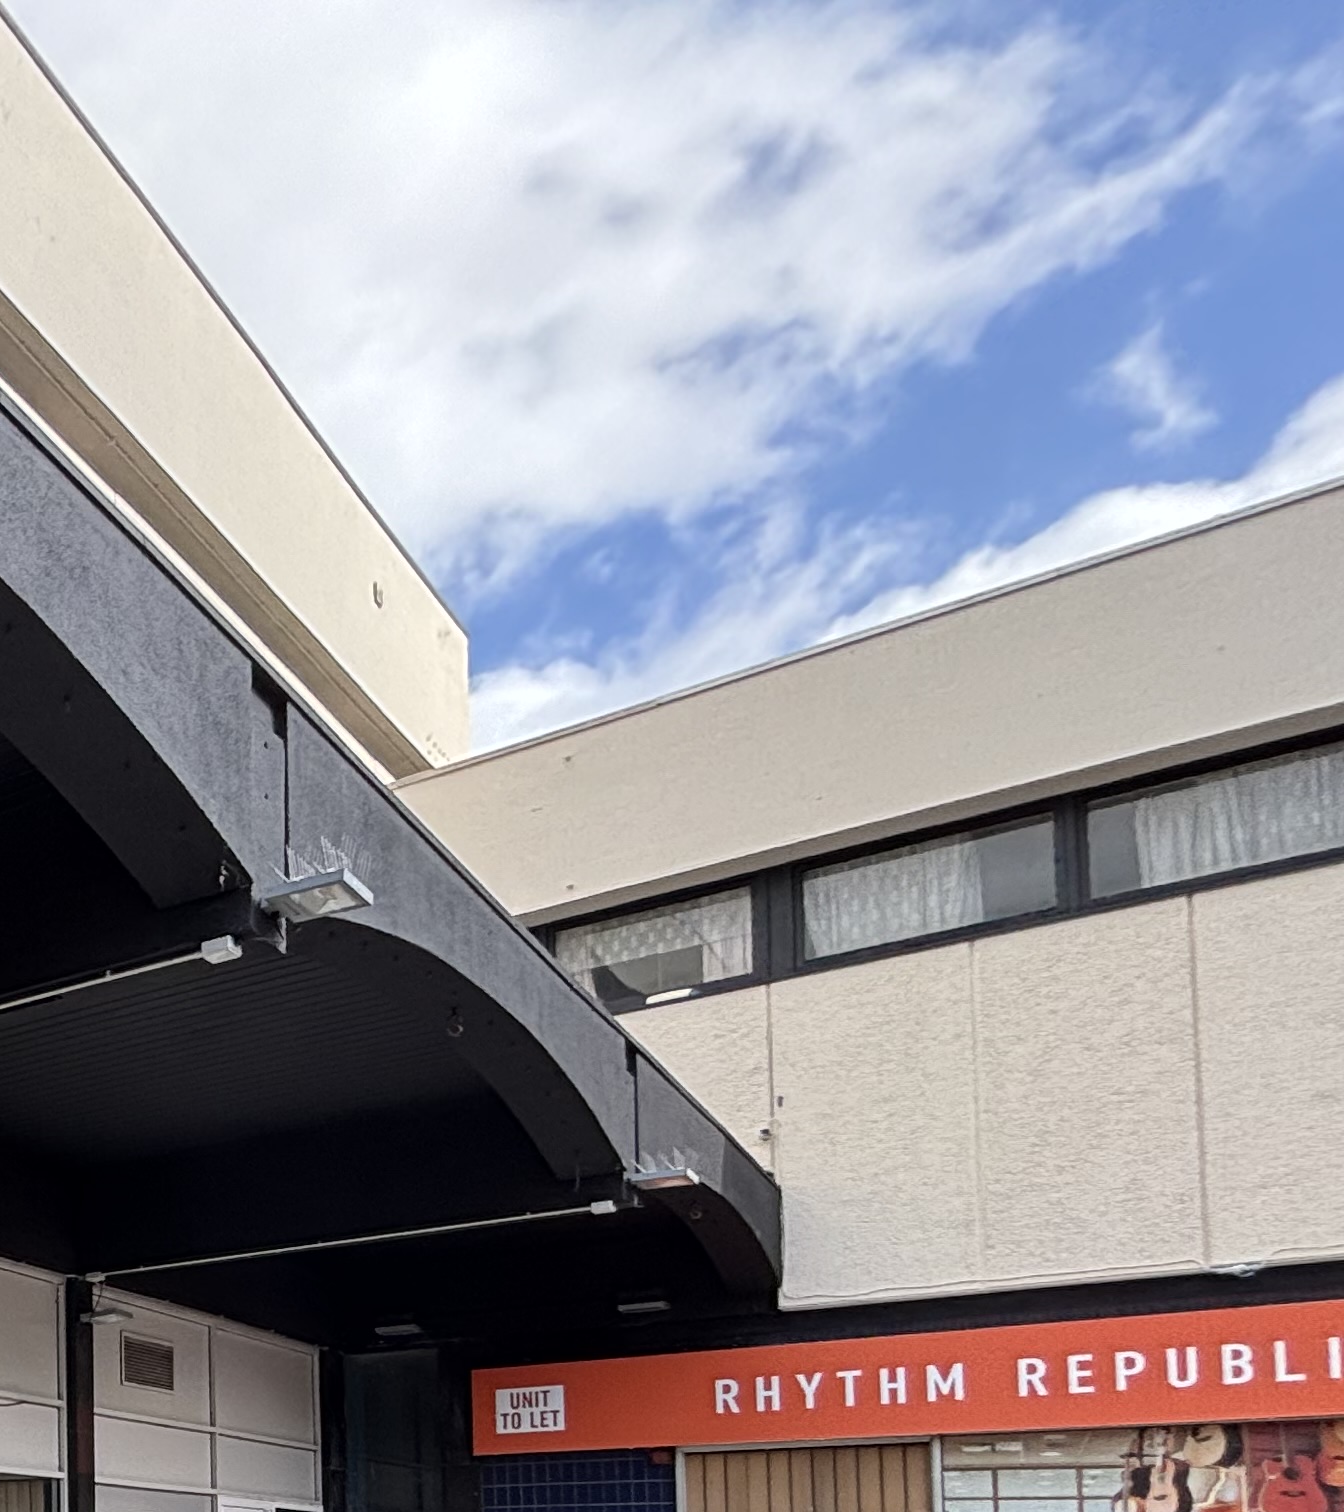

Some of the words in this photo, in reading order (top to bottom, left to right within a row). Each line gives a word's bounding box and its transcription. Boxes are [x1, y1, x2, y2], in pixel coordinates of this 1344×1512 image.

[713, 1361, 966, 1415] RHYTHM
[509, 1390, 551, 1410] UNIT
[500, 1412, 522, 1430] TO
[529, 1410, 560, 1429] LET
